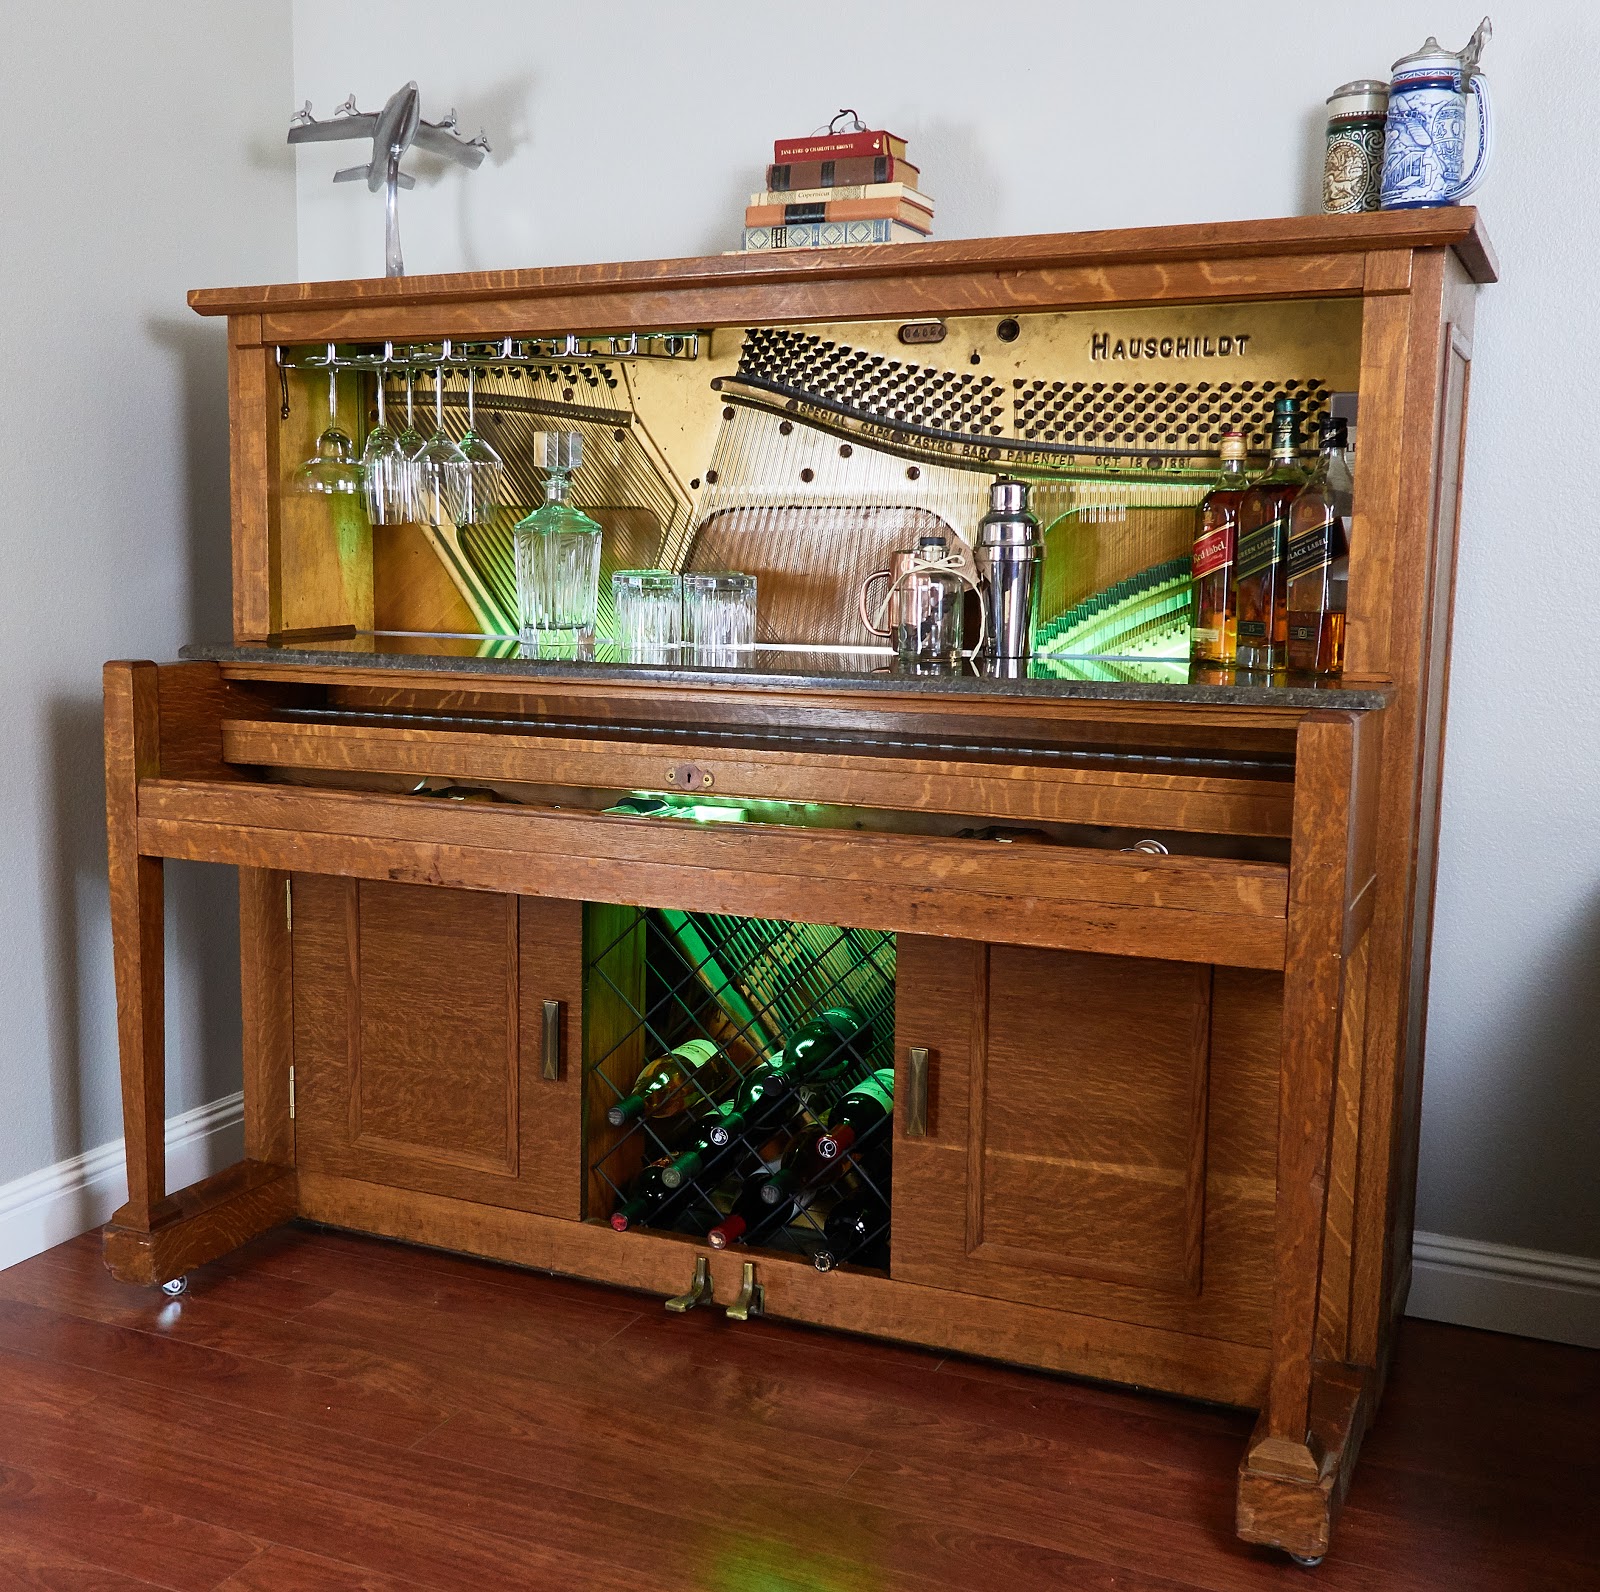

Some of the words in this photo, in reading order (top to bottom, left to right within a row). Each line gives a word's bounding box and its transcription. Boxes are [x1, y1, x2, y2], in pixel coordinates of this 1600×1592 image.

[800, 403, 847, 426] SPECIAL
[861, 422, 889, 438] CAPO
[962, 444, 987, 458] BAR
[1007, 450, 1075, 466] PATENTED
[1095, 456, 1120, 468] OCT
[1130, 457, 1143, 469] 18
[1206, 541, 1227, 556] Label
[1307, 538, 1328, 552] LABEL
